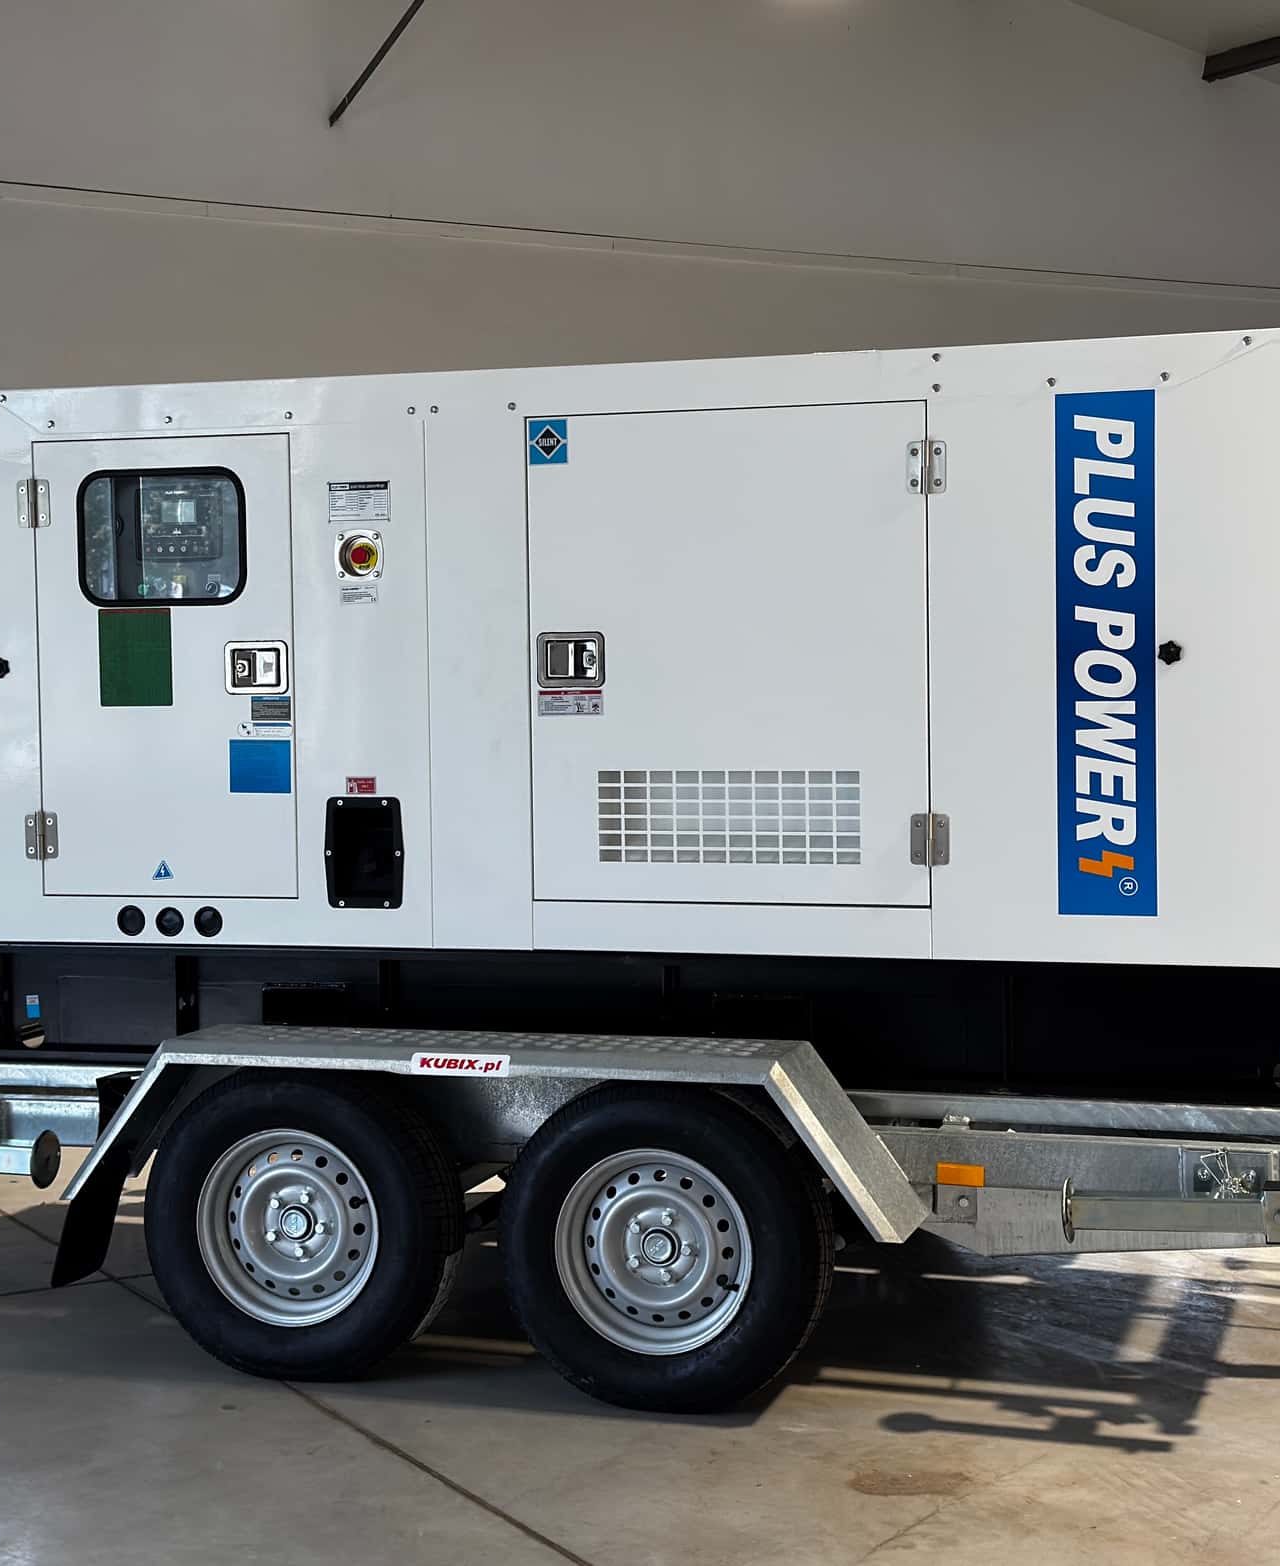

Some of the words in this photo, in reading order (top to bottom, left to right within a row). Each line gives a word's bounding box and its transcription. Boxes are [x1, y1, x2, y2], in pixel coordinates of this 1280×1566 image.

[538, 438, 558, 447] SILENT
[1073, 414, 1137, 588] PLUS
[1073, 605, 1137, 846] POWER
[419, 1057, 503, 1073] KUBIX.pl
